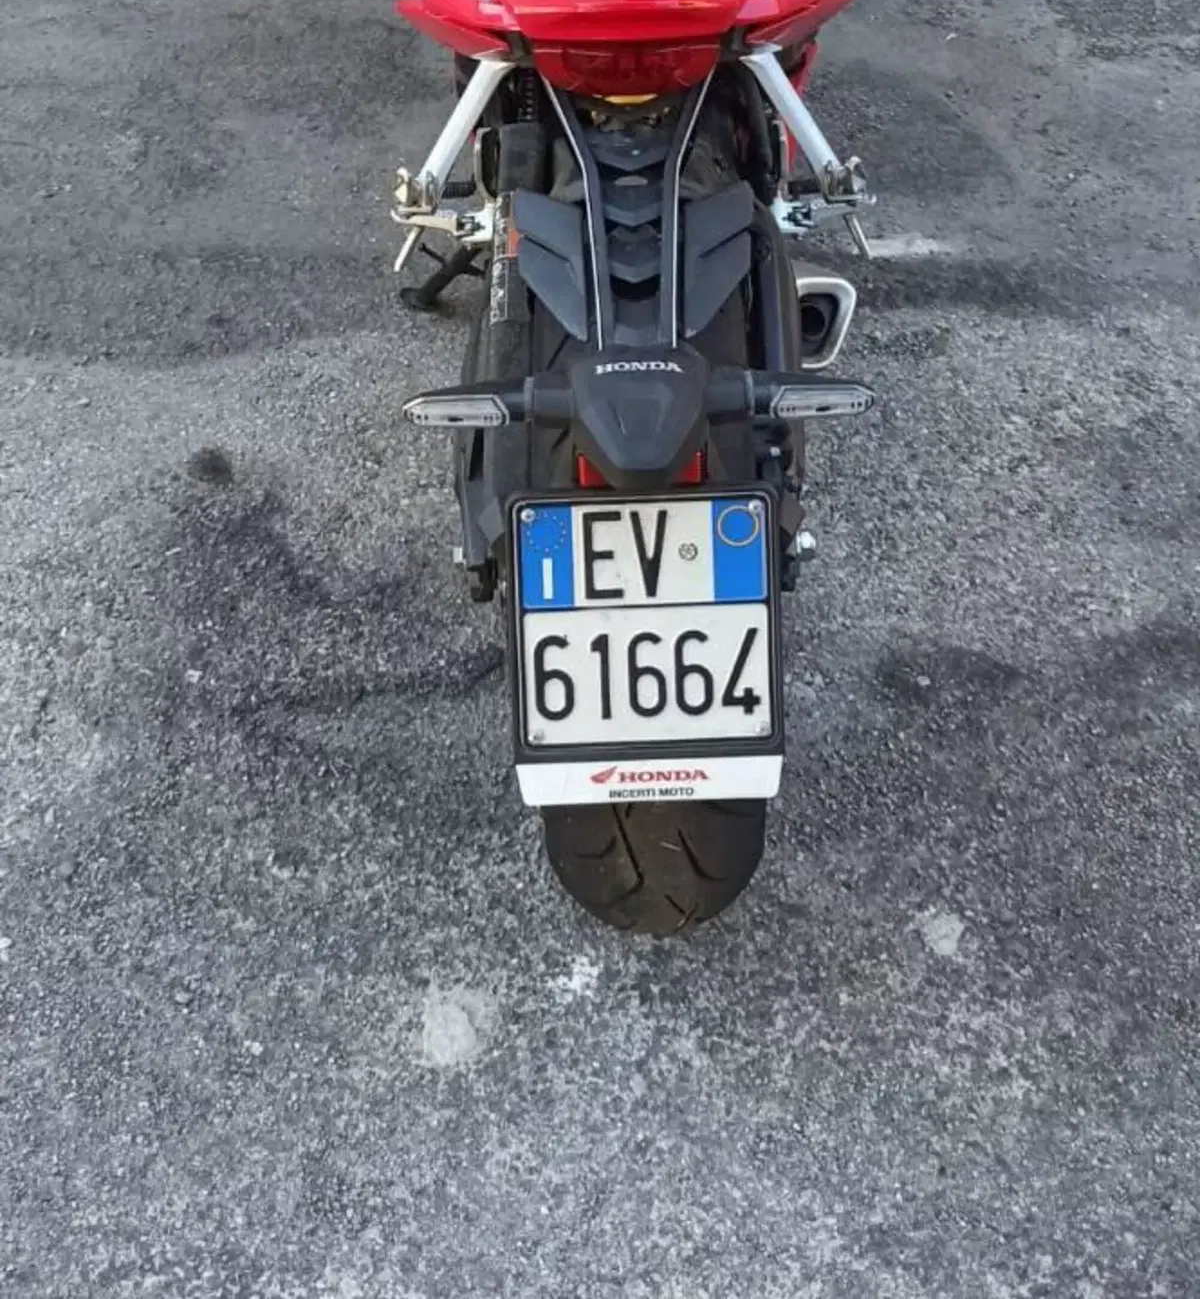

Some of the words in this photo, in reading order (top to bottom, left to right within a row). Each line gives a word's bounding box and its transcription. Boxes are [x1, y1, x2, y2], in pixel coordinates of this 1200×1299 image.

[595, 361, 684, 374] HONDA
[582, 510, 667, 599] EV
[533, 627, 761, 721] 61664
[619, 769, 709, 783] HONDA
[608, 788, 656, 799] INCERTI
[659, 786, 694, 797] MOTO
